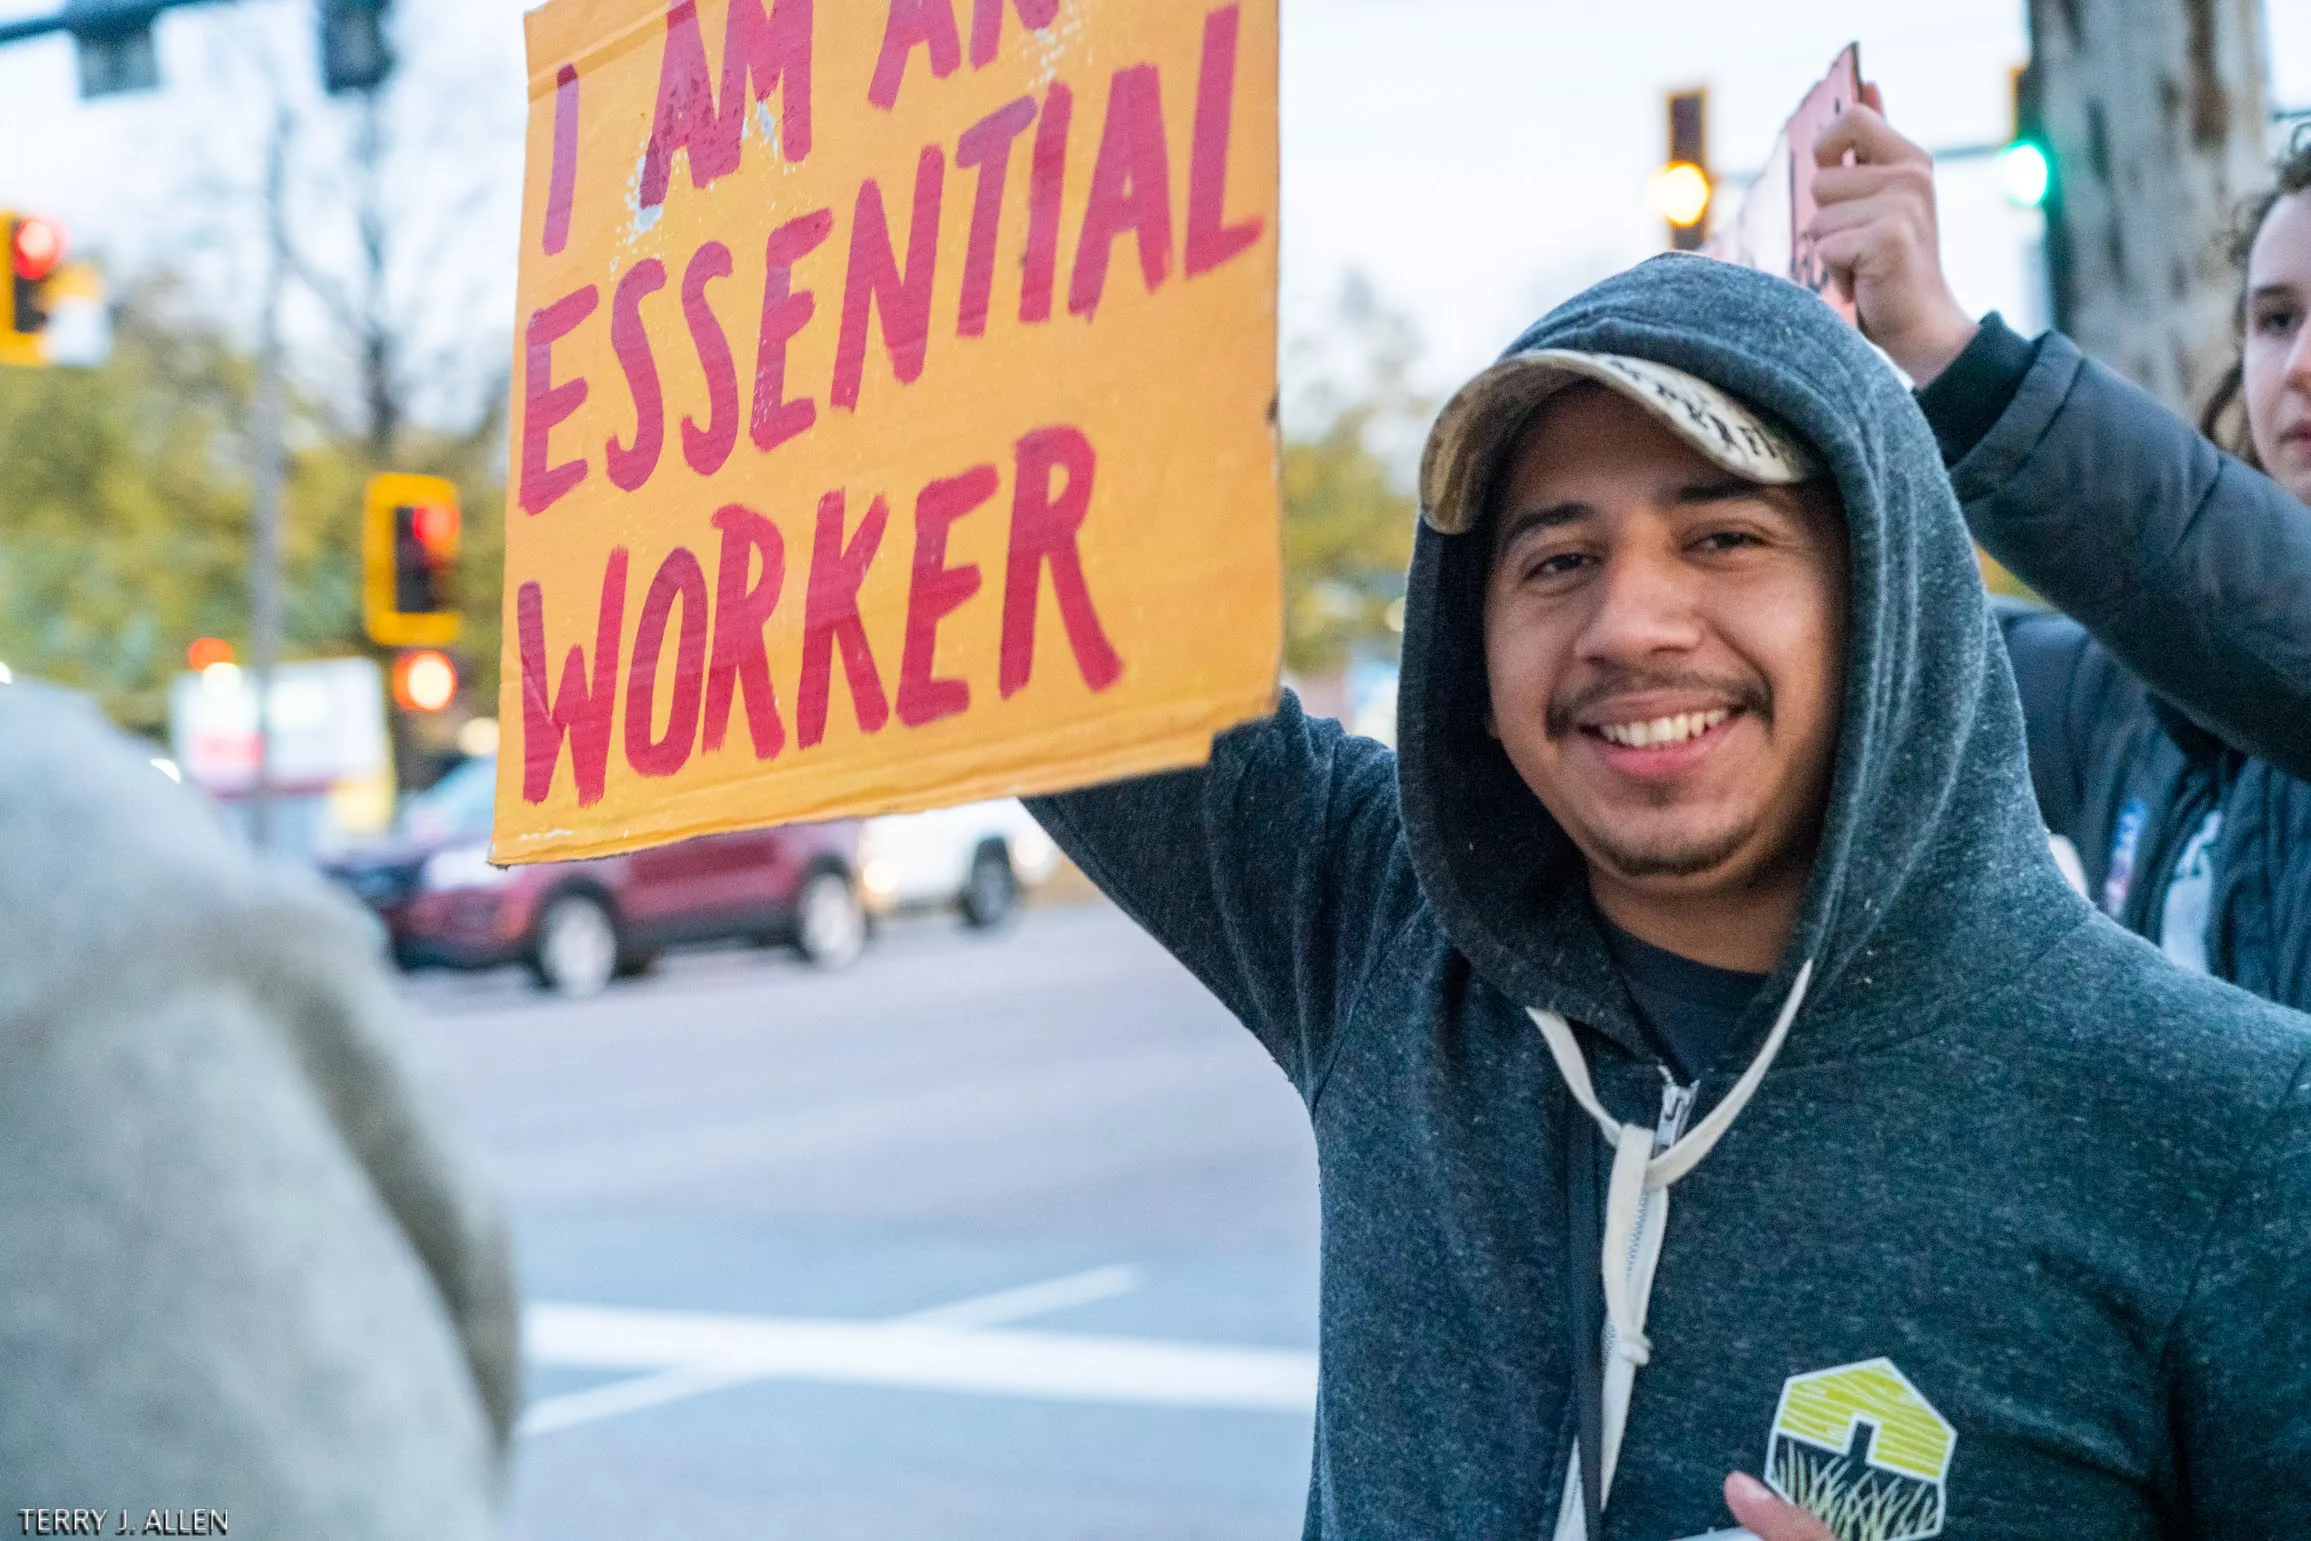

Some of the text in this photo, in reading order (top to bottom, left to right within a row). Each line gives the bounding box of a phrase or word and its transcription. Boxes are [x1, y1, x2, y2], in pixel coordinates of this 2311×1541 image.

[520, 4, 1263, 516] ESSENTIAL
[542, 63, 579, 256] I
[640, 0, 814, 209] AM
[517, 424, 1123, 807] WORKER
